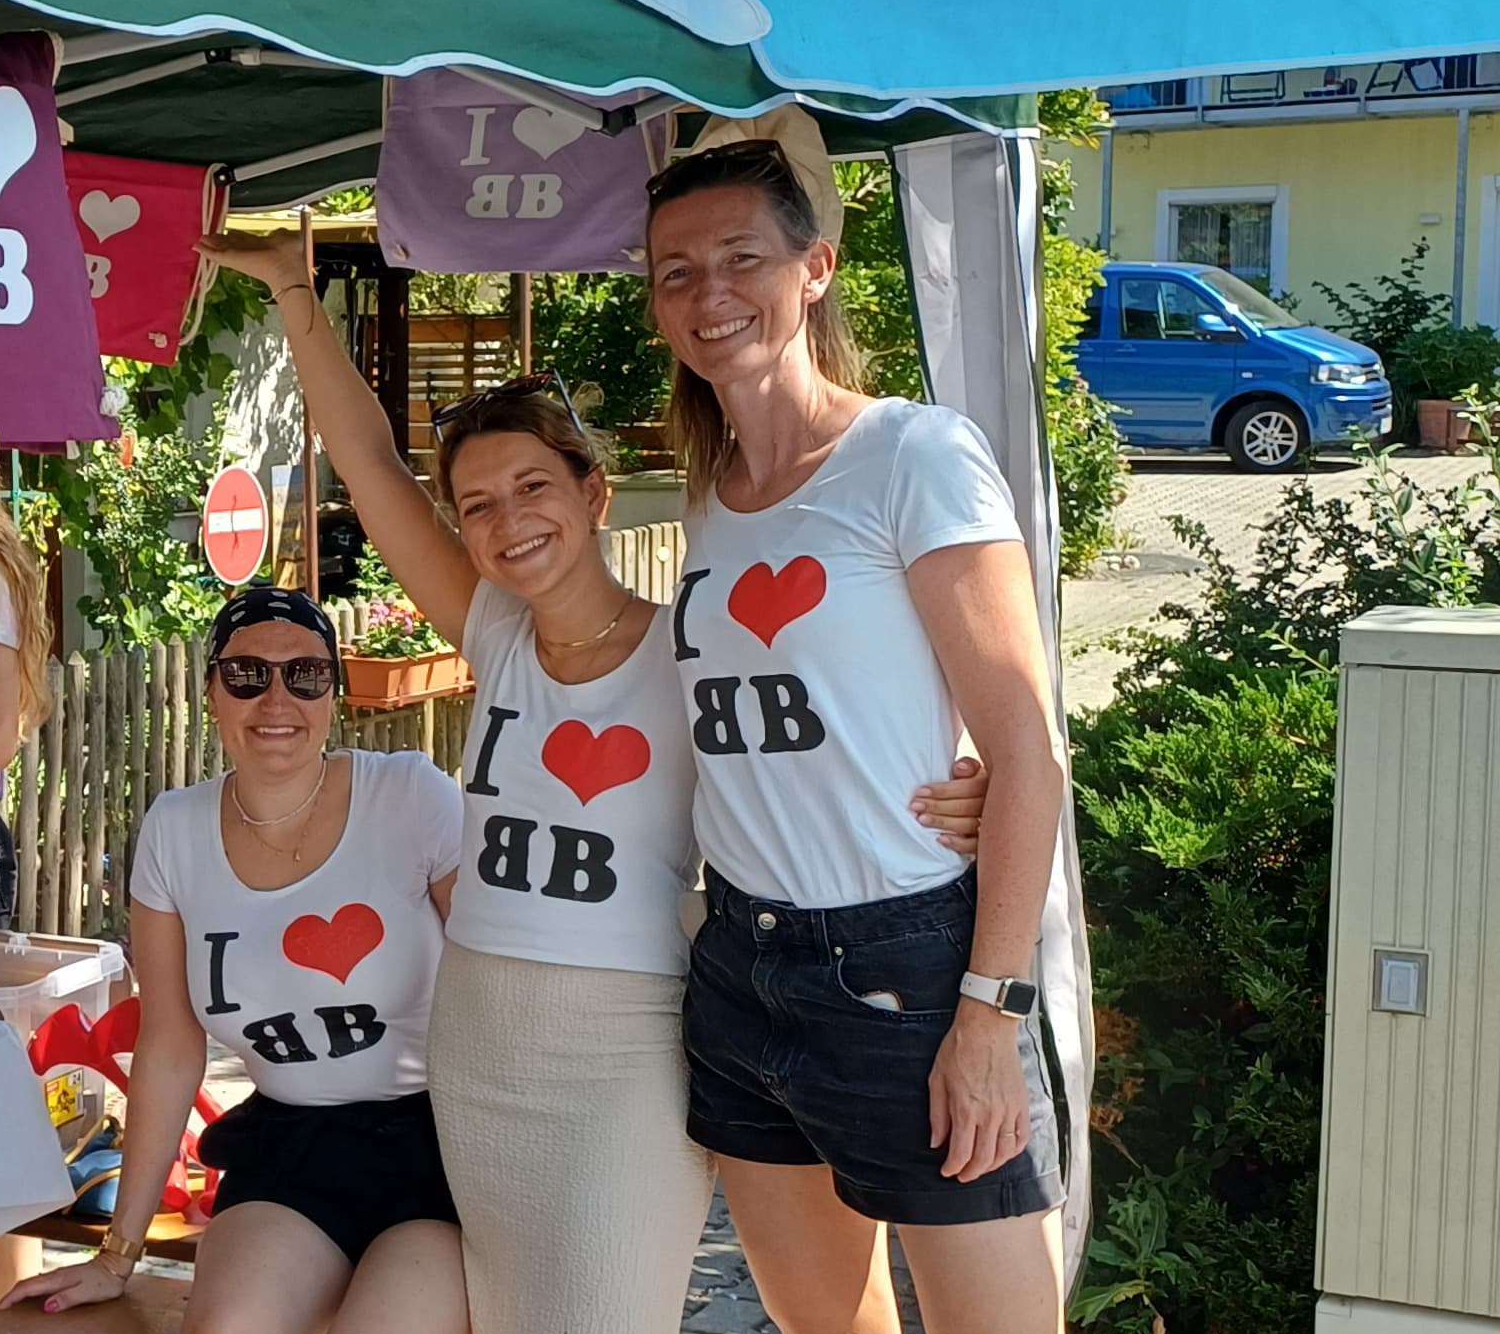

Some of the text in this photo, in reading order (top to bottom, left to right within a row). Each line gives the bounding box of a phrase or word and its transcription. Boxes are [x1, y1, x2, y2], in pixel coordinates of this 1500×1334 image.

[460, 107, 496, 166] I
[466, 706, 520, 797] I
[204, 932, 241, 1016] I
